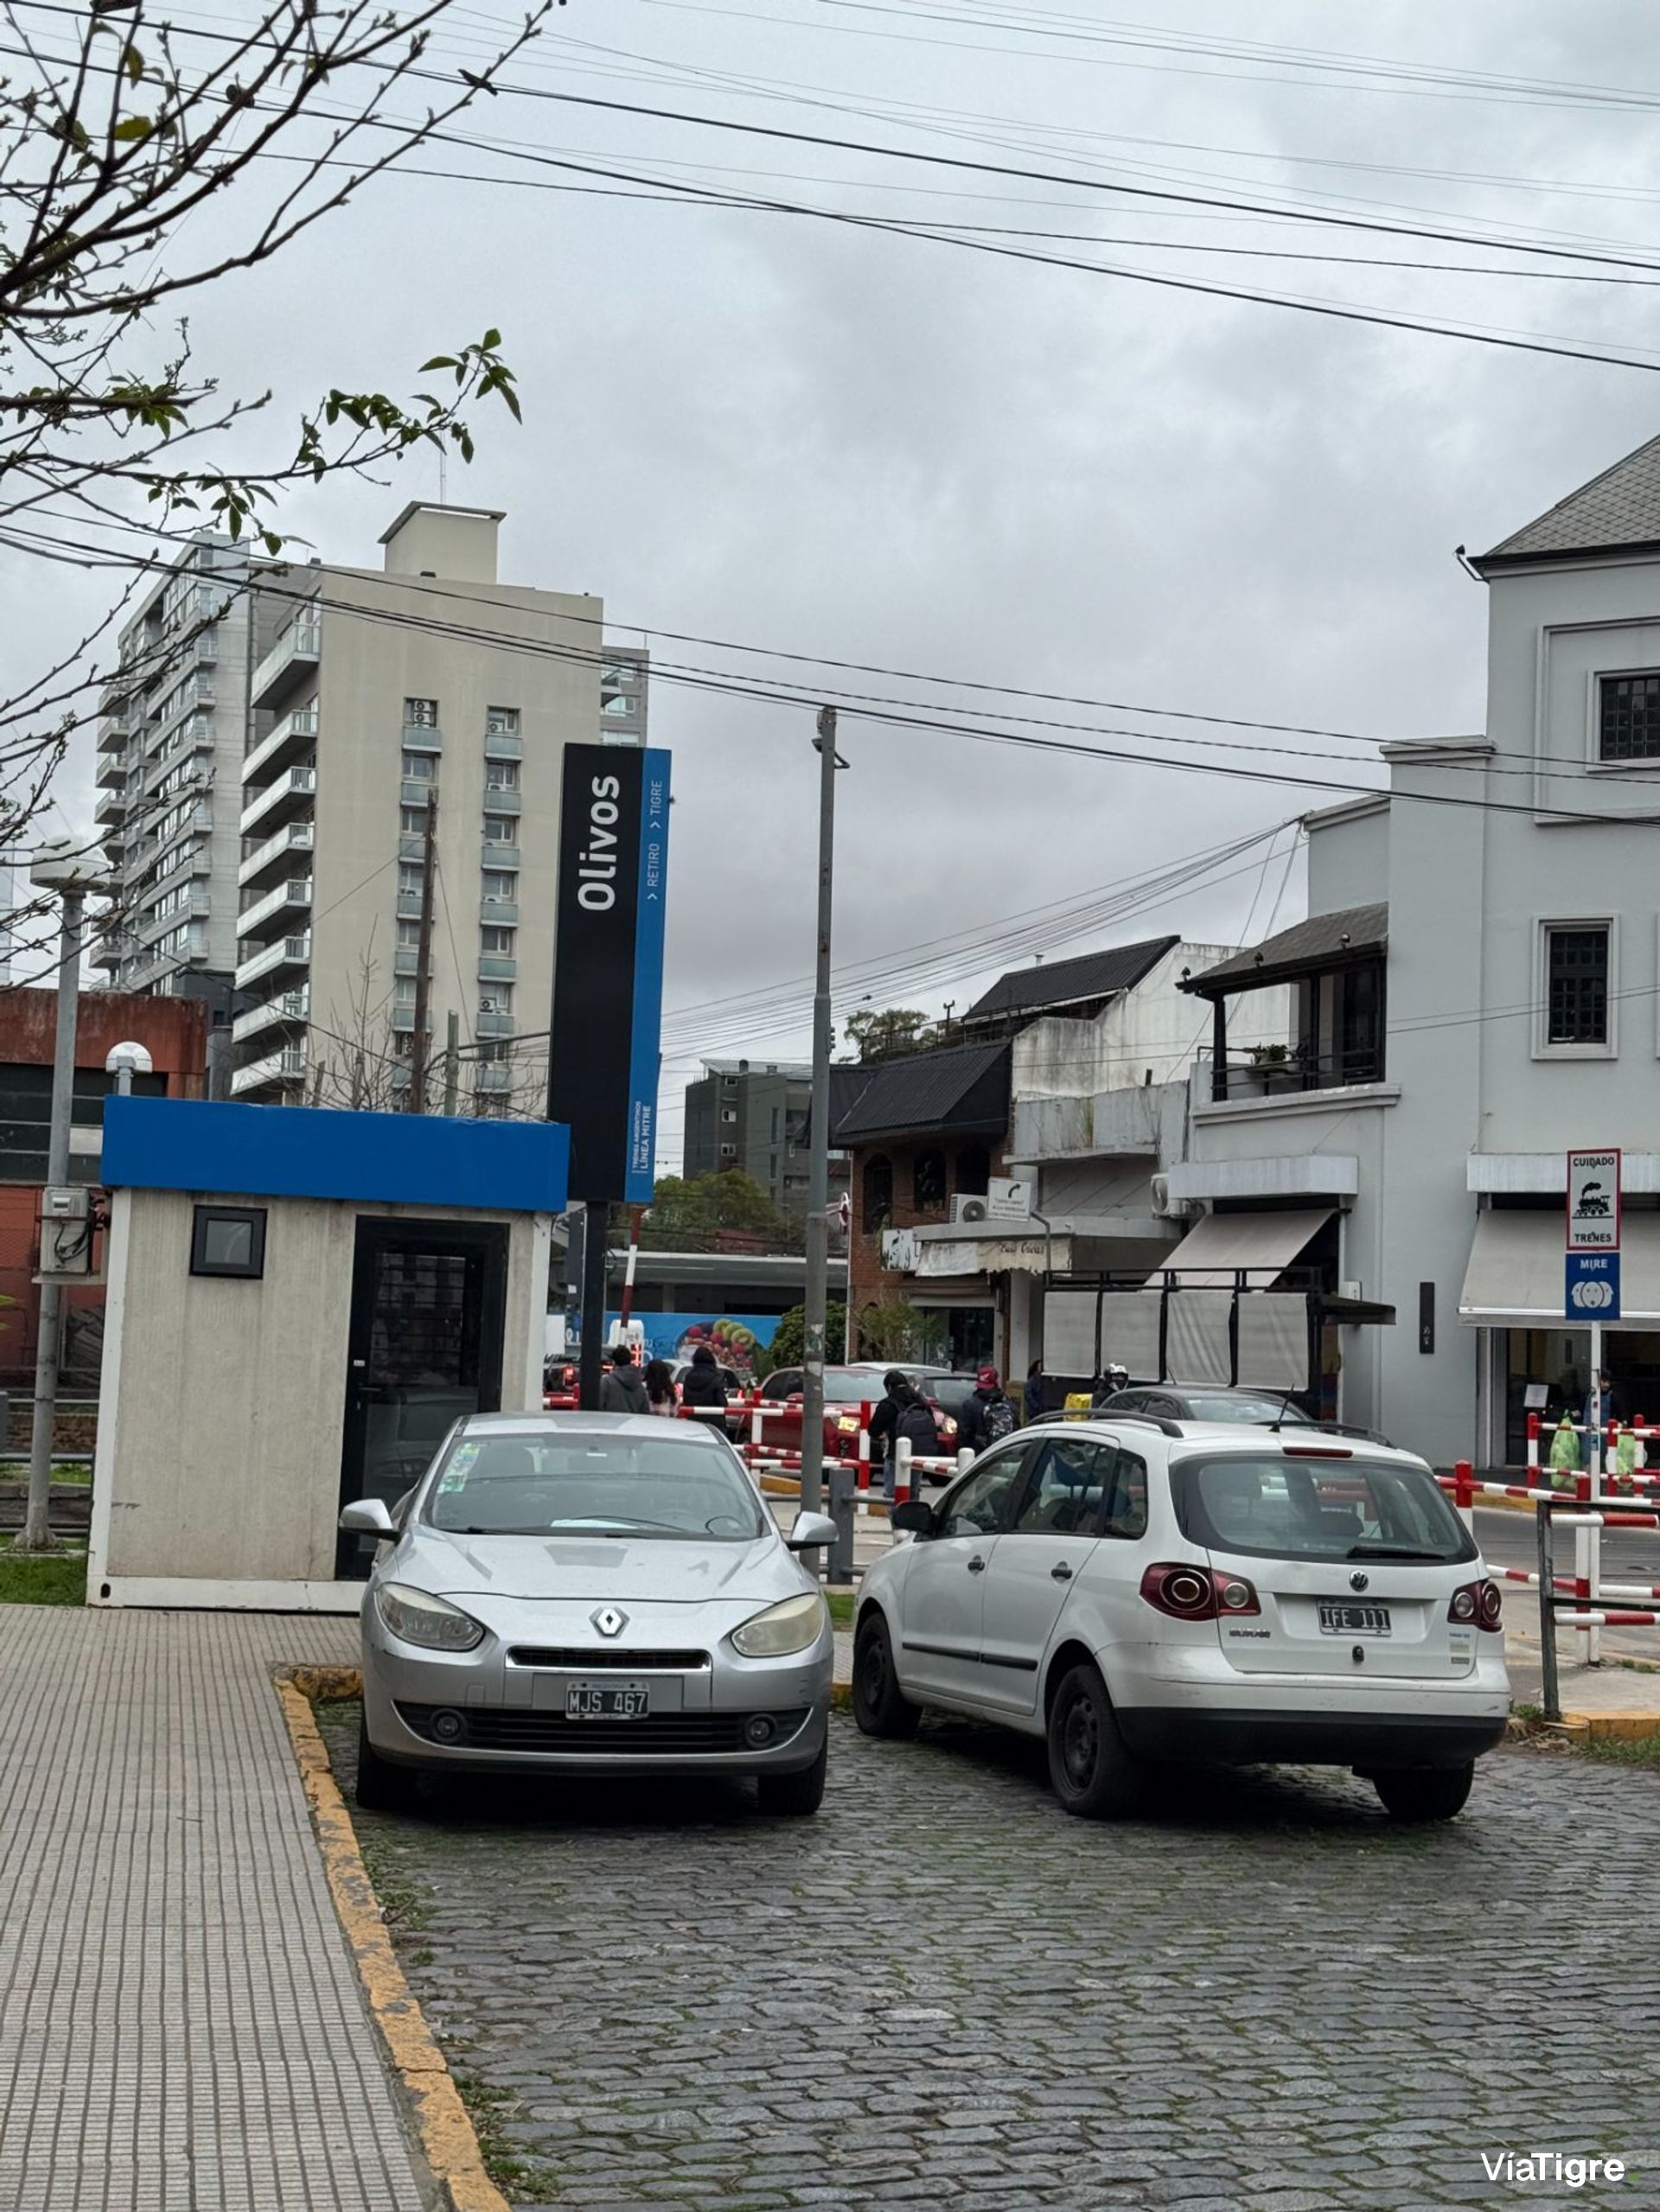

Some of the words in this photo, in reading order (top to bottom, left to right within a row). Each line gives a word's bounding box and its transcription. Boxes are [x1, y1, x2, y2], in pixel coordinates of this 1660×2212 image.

[650, 780, 663, 815] TIGRE
[578, 776, 620, 910] Olivos
[648, 843, 660, 887] RETIRO
[642, 1106, 651, 1137] MITRE
[1573, 1156, 1615, 1167] CUIDADO
[1574, 1233, 1612, 1243] TRENES
[1580, 1259, 1608, 1270] MIRE
[1321, 1608, 1351, 1628] IFE
[1360, 1610, 1389, 1629] 111
[569, 1692, 603, 1712] MJS
[613, 1692, 646, 1713] 467
